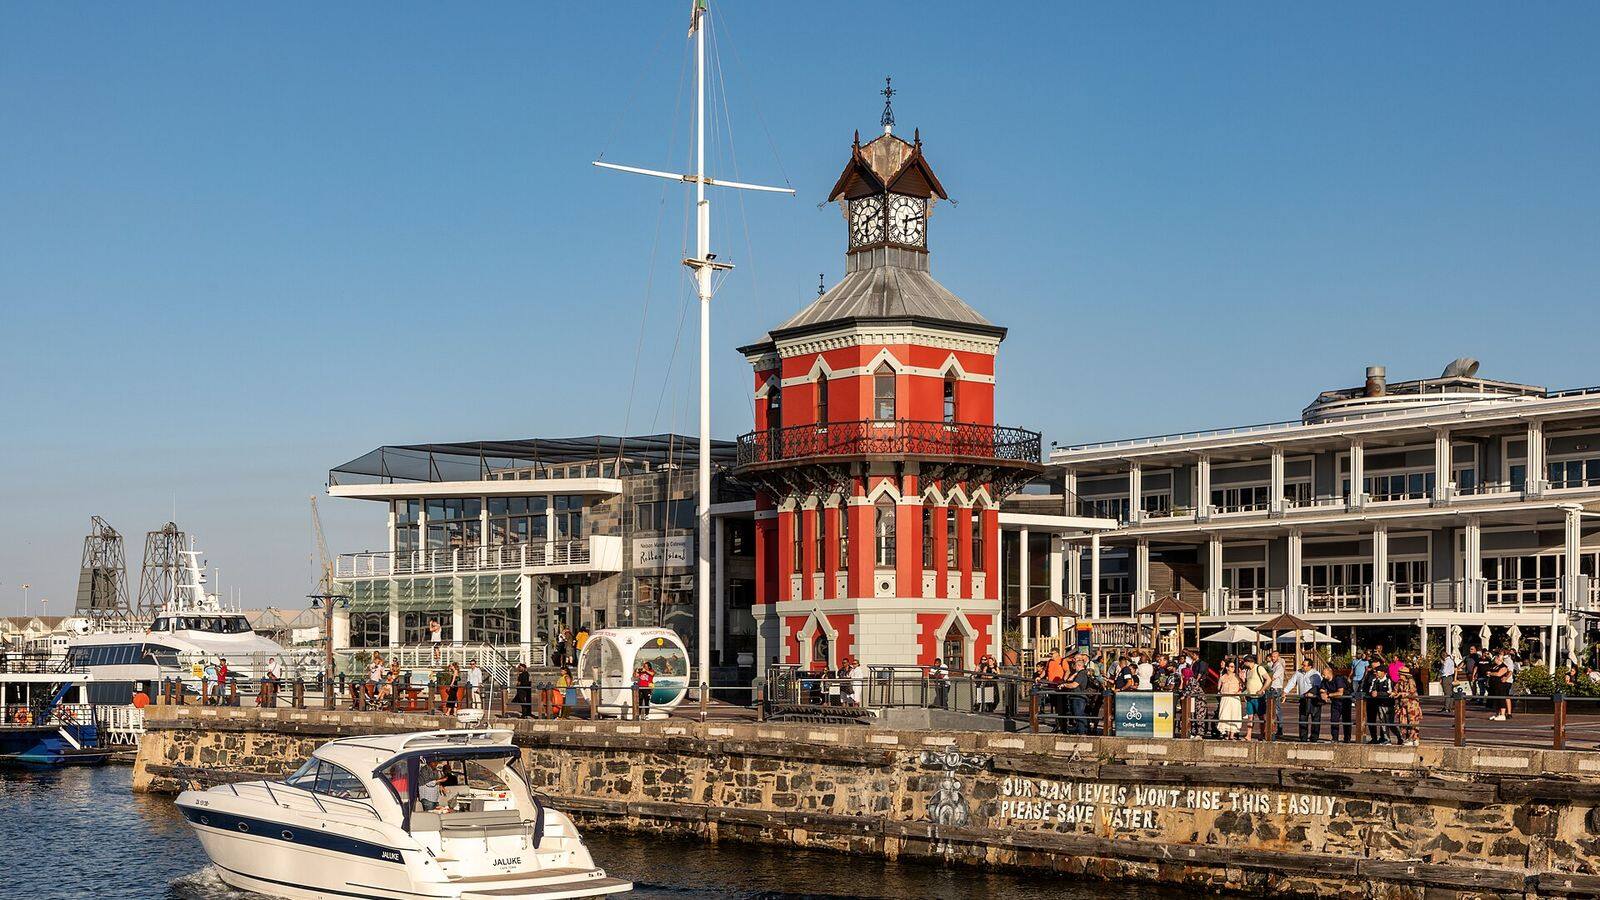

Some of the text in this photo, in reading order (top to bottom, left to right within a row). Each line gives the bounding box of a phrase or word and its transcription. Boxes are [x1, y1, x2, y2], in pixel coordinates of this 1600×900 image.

[1002, 777, 1340, 817] OUR DAM LEVELS WON'T RISE THIS EASILY.
[1000, 800, 1158, 829] PLEASE SAVE WATER.
[381, 851, 399, 861] JALUKE
[492, 856, 522, 867] JALUKE
